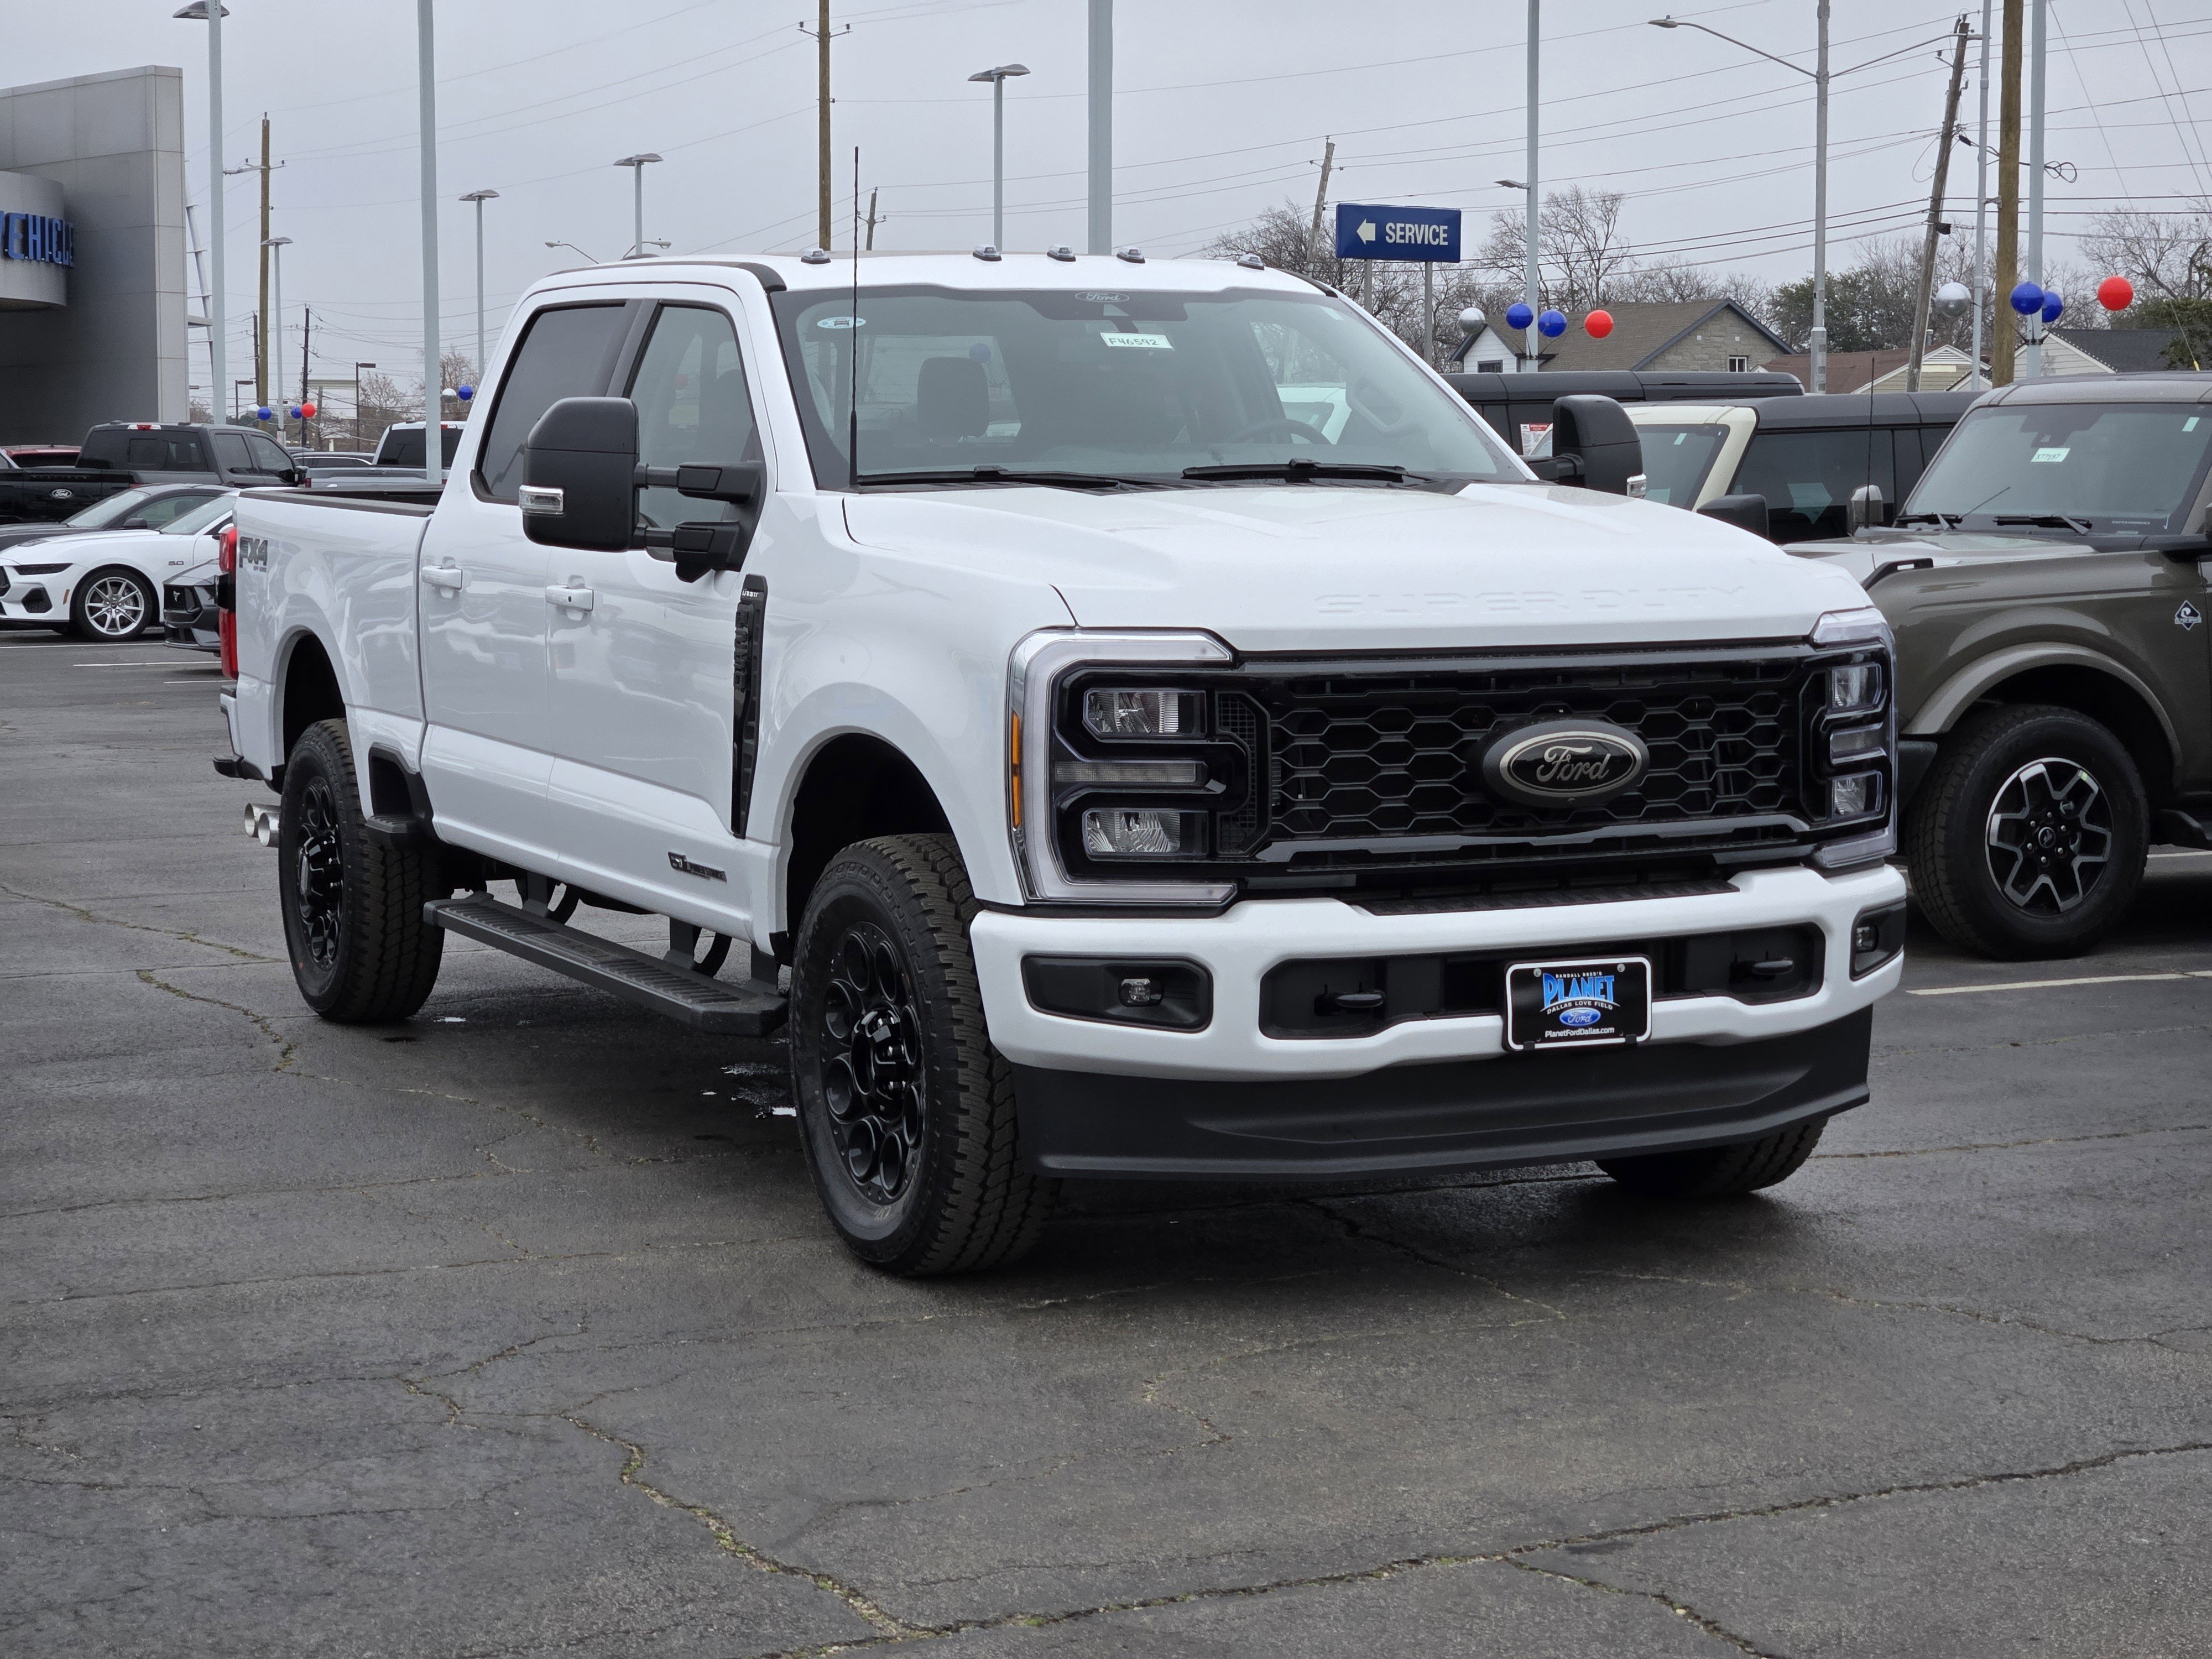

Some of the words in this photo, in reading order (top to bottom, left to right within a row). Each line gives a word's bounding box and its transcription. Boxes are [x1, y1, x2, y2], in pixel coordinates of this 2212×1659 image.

[1385, 222, 1449, 246] SERVICE
[1086, 292, 1120, 301] Ford
[1108, 337, 1159, 346] F46592
[239, 536, 268, 568] FX4
[1314, 589, 1569, 616] SUPER
[1580, 585, 1745, 612] DUTY
[1536, 745, 1610, 782] Ford
[1542, 972, 1615, 1008] PLANET
[1547, 1003, 1572, 1015] DALLAS
[1594, 1001, 1613, 1010] FIELD
[1567, 1011, 1593, 1024] Ford
[1545, 1027, 1615, 1037] PlanetFordDallas.com
